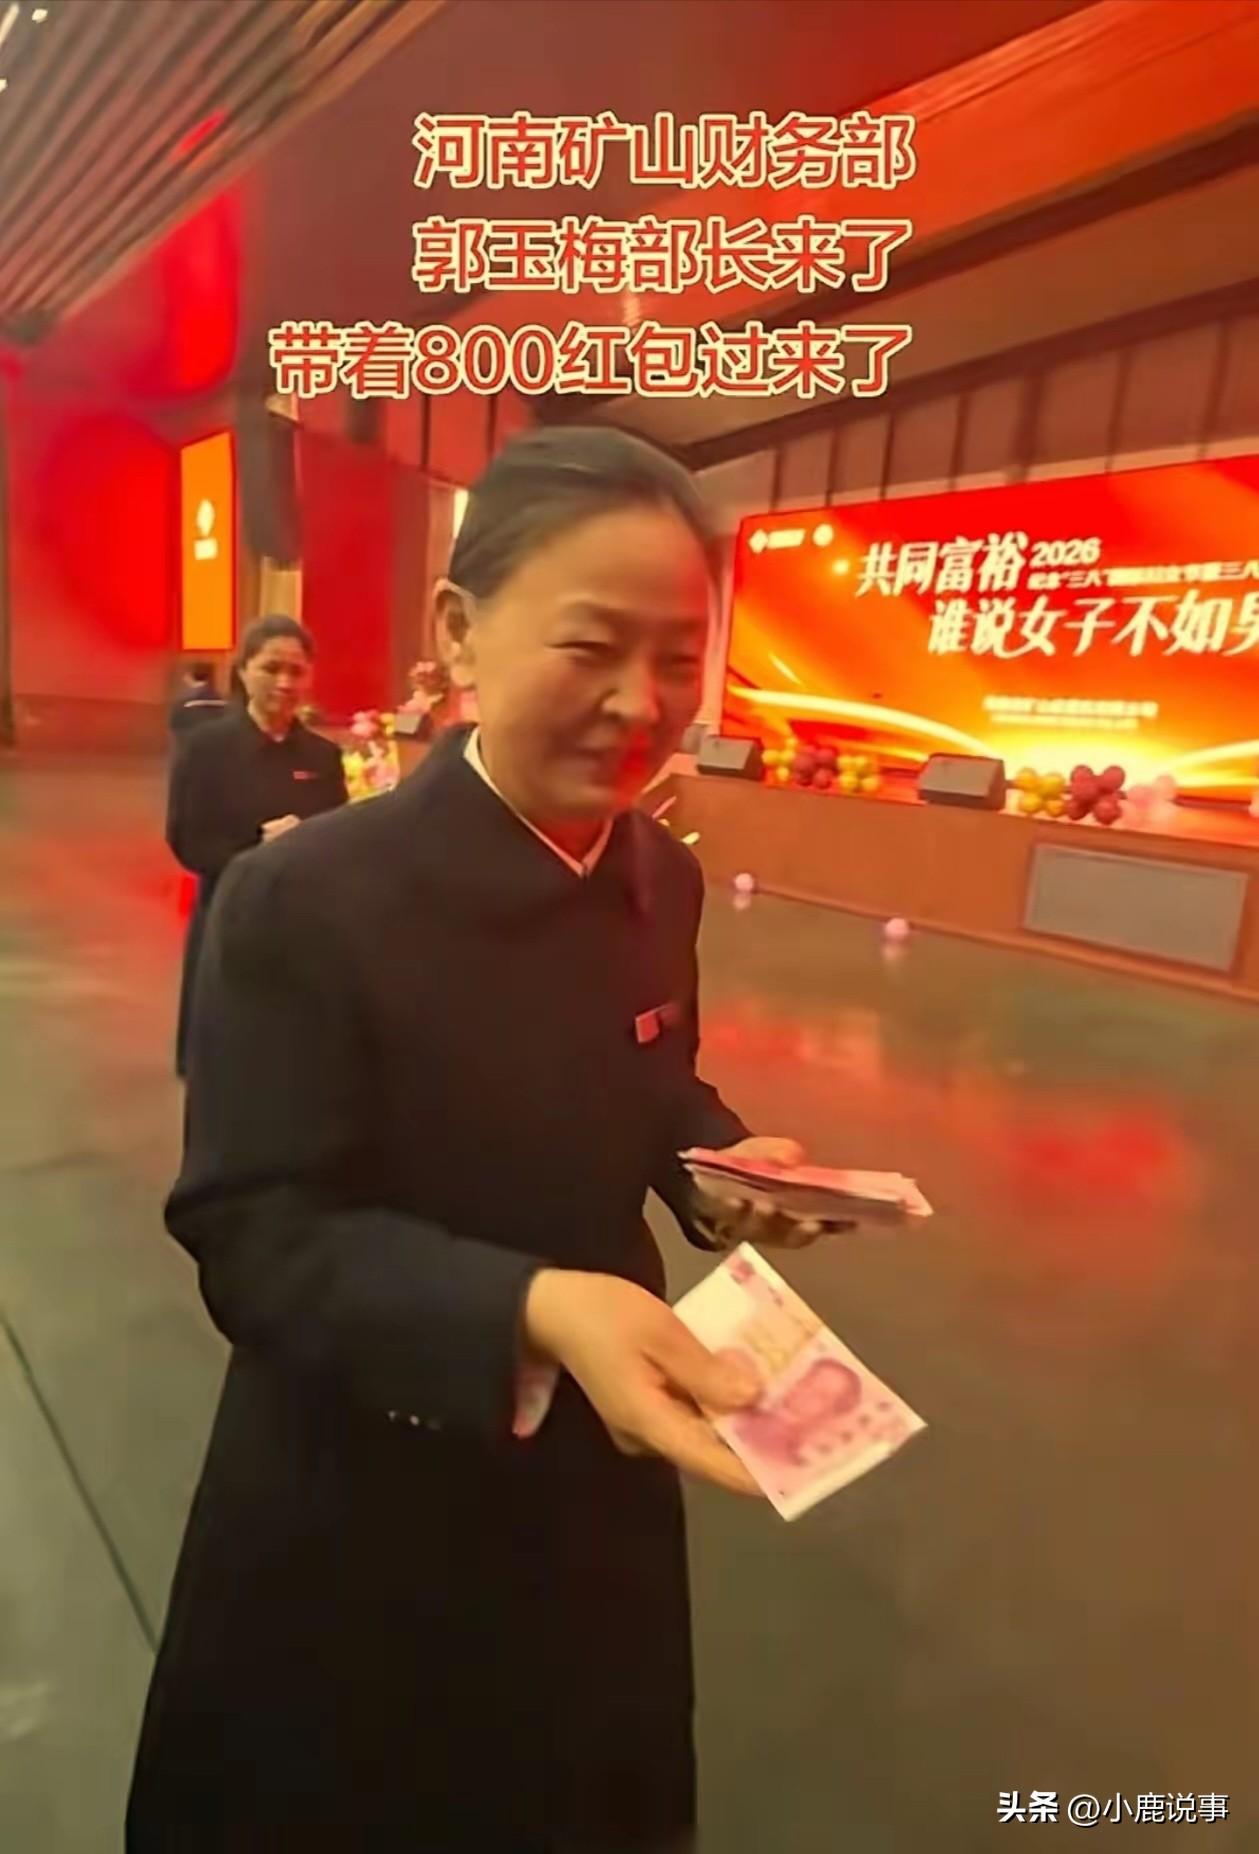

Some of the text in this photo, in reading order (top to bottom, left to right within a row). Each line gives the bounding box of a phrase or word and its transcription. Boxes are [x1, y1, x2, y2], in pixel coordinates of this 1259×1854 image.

[857, 533, 1028, 596] 共同富裕
[1030, 538, 1101, 566] 2026
